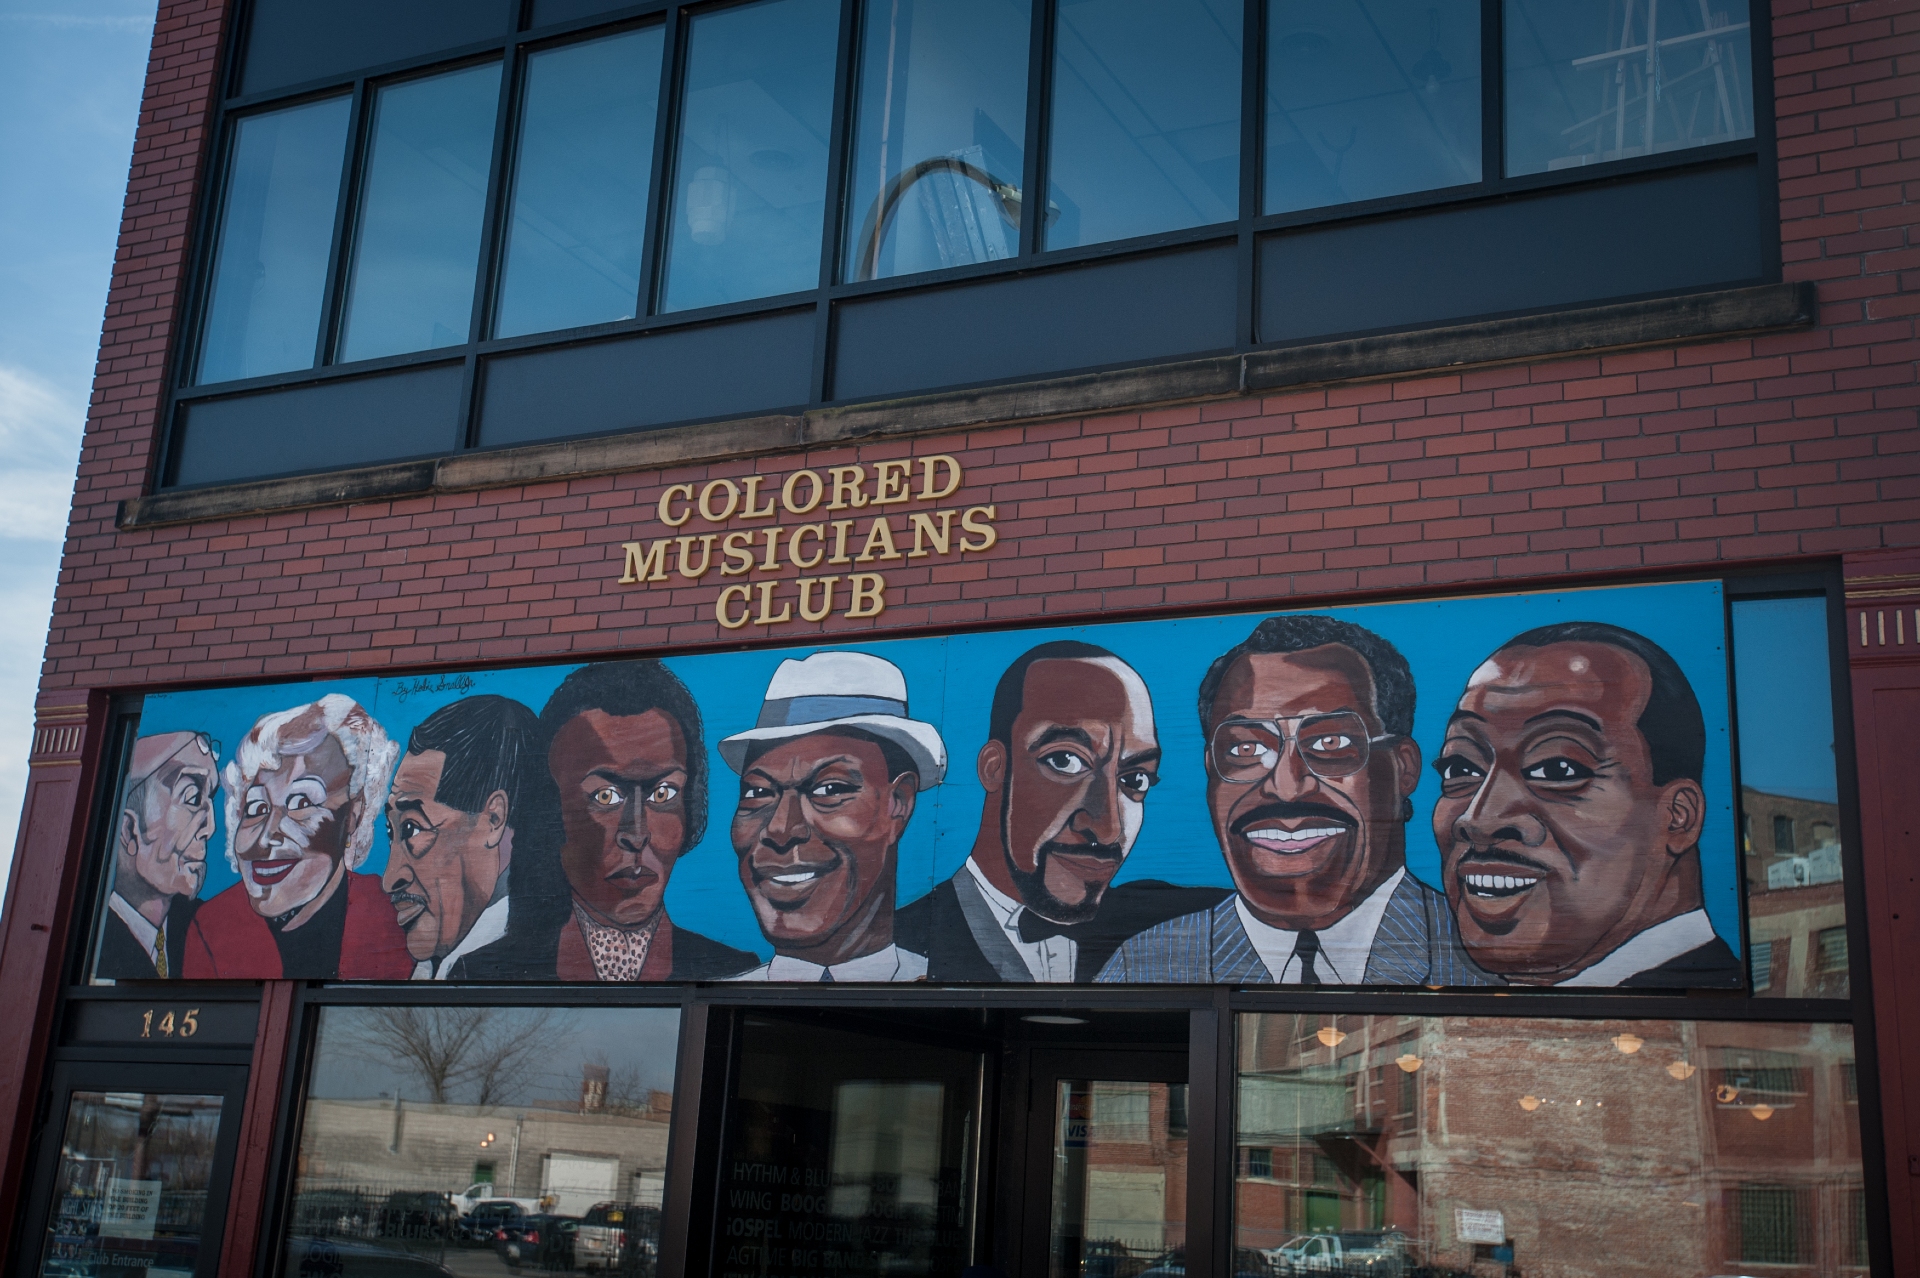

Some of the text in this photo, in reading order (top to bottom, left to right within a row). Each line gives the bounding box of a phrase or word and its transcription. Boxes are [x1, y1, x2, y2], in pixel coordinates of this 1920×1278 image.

[658, 454, 963, 528] COLORED
[617, 504, 999, 585] MUSICIANS
[714, 572, 887, 630] CLUB
[140, 1008, 200, 1038] 145
[120, 1189, 146, 1197] SMOKING
[122, 1196, 149, 1205] BUILDING
[788, 1221, 853, 1242] MODERN
[87, 1252, 155, 1268] Club Entrance
[791, 1248, 818, 1268] BIG
